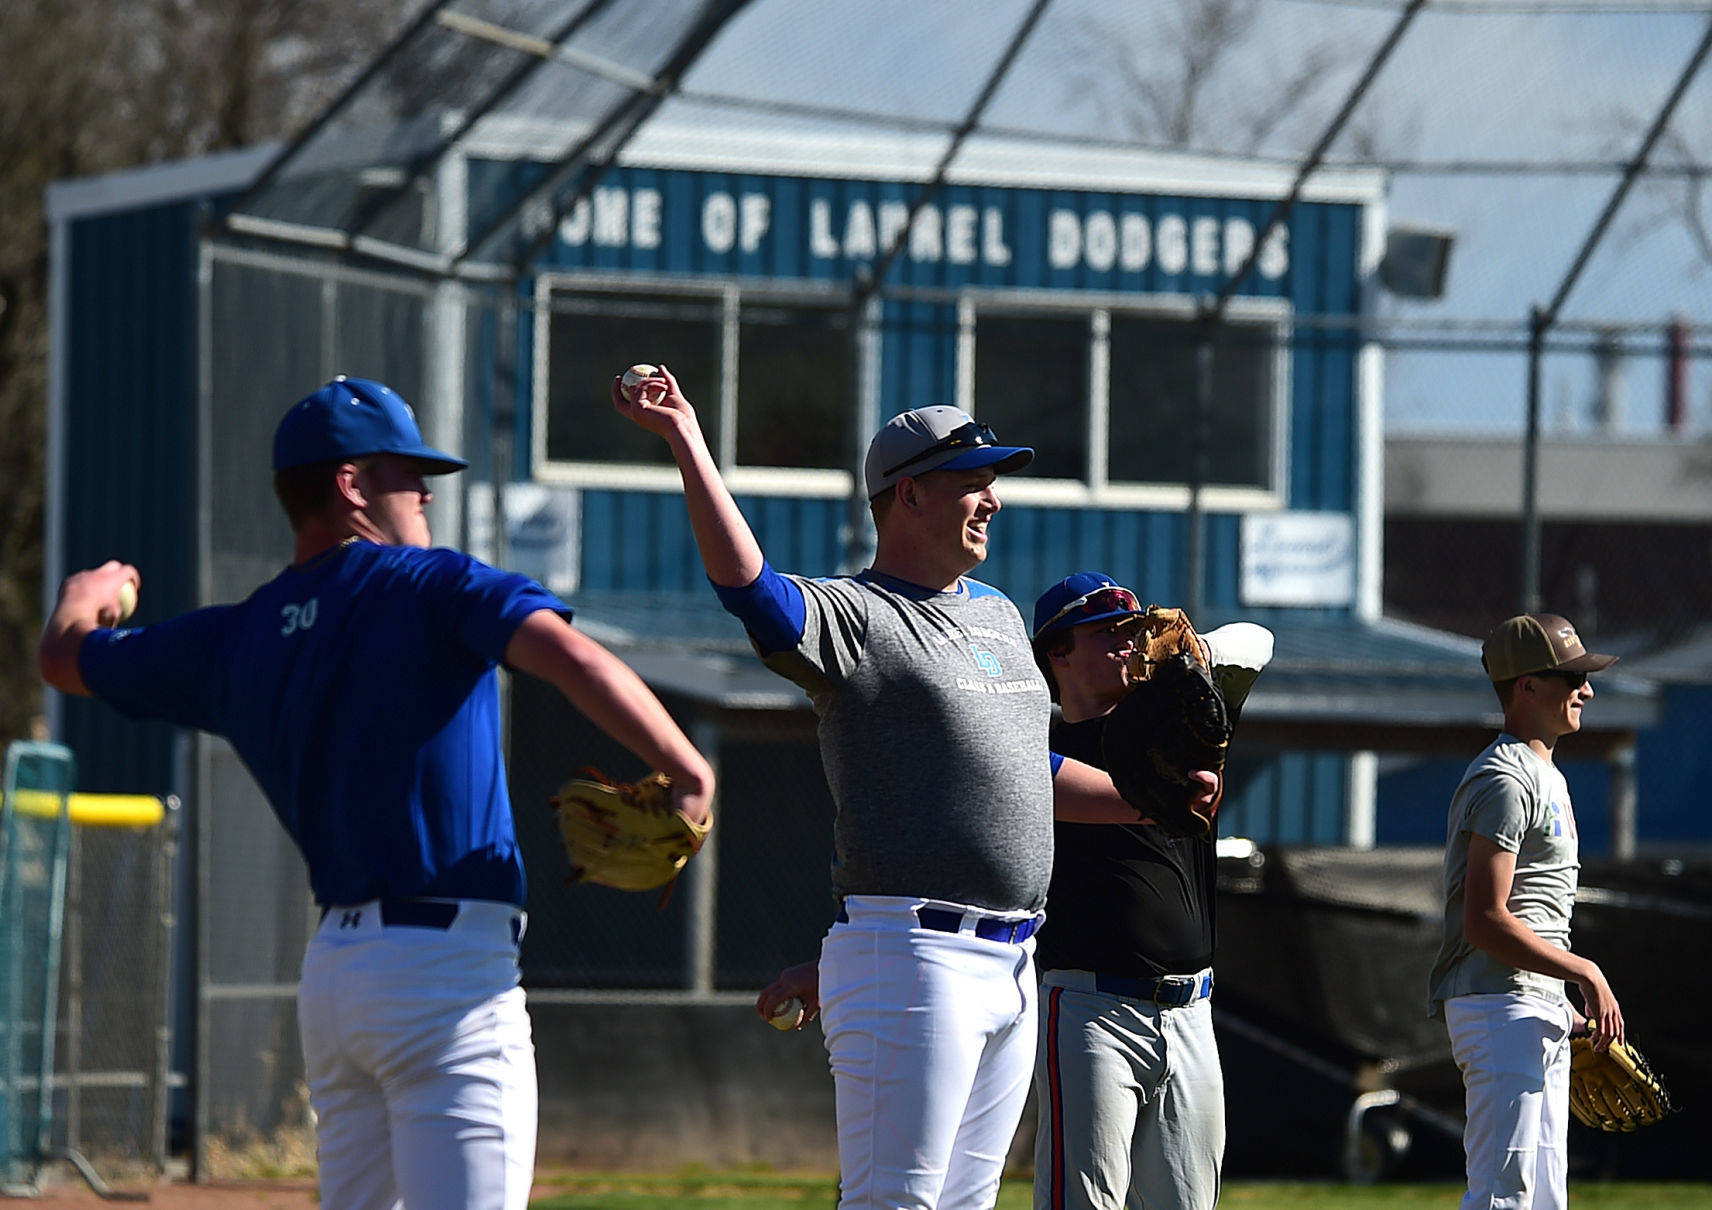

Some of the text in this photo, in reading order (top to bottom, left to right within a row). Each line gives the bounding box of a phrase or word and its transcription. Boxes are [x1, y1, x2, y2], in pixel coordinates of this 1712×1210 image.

[702, 191, 771, 254] OF
[1048, 208, 1290, 281] DODGERS
[281, 598, 319, 636] 30
[995, 679, 1044, 694] BASEBALL
